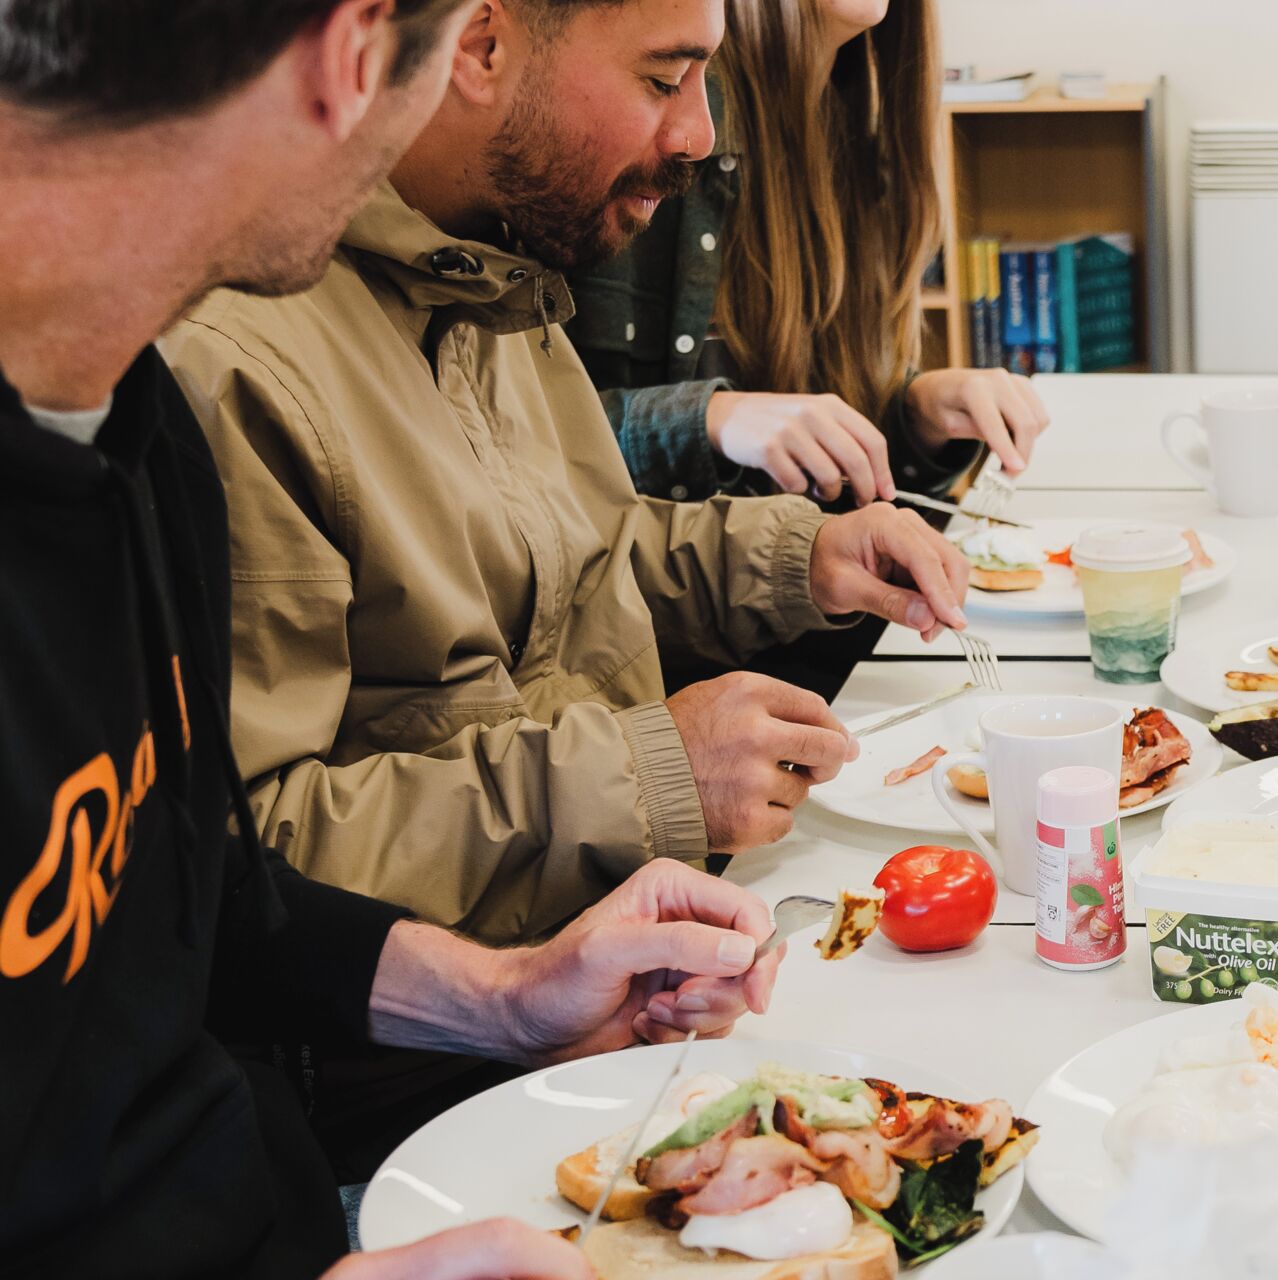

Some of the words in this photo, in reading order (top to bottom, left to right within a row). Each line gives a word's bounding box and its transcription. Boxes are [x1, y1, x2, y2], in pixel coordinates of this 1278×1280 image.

[1156, 915, 1176, 934] FREE
[1209, 924, 1230, 932] healthy
[1217, 954, 1253, 969] Olive
[1256, 957, 1277, 971] Oil
[1166, 981, 1178, 990] 375
[1213, 987, 1233, 997] Dairy
